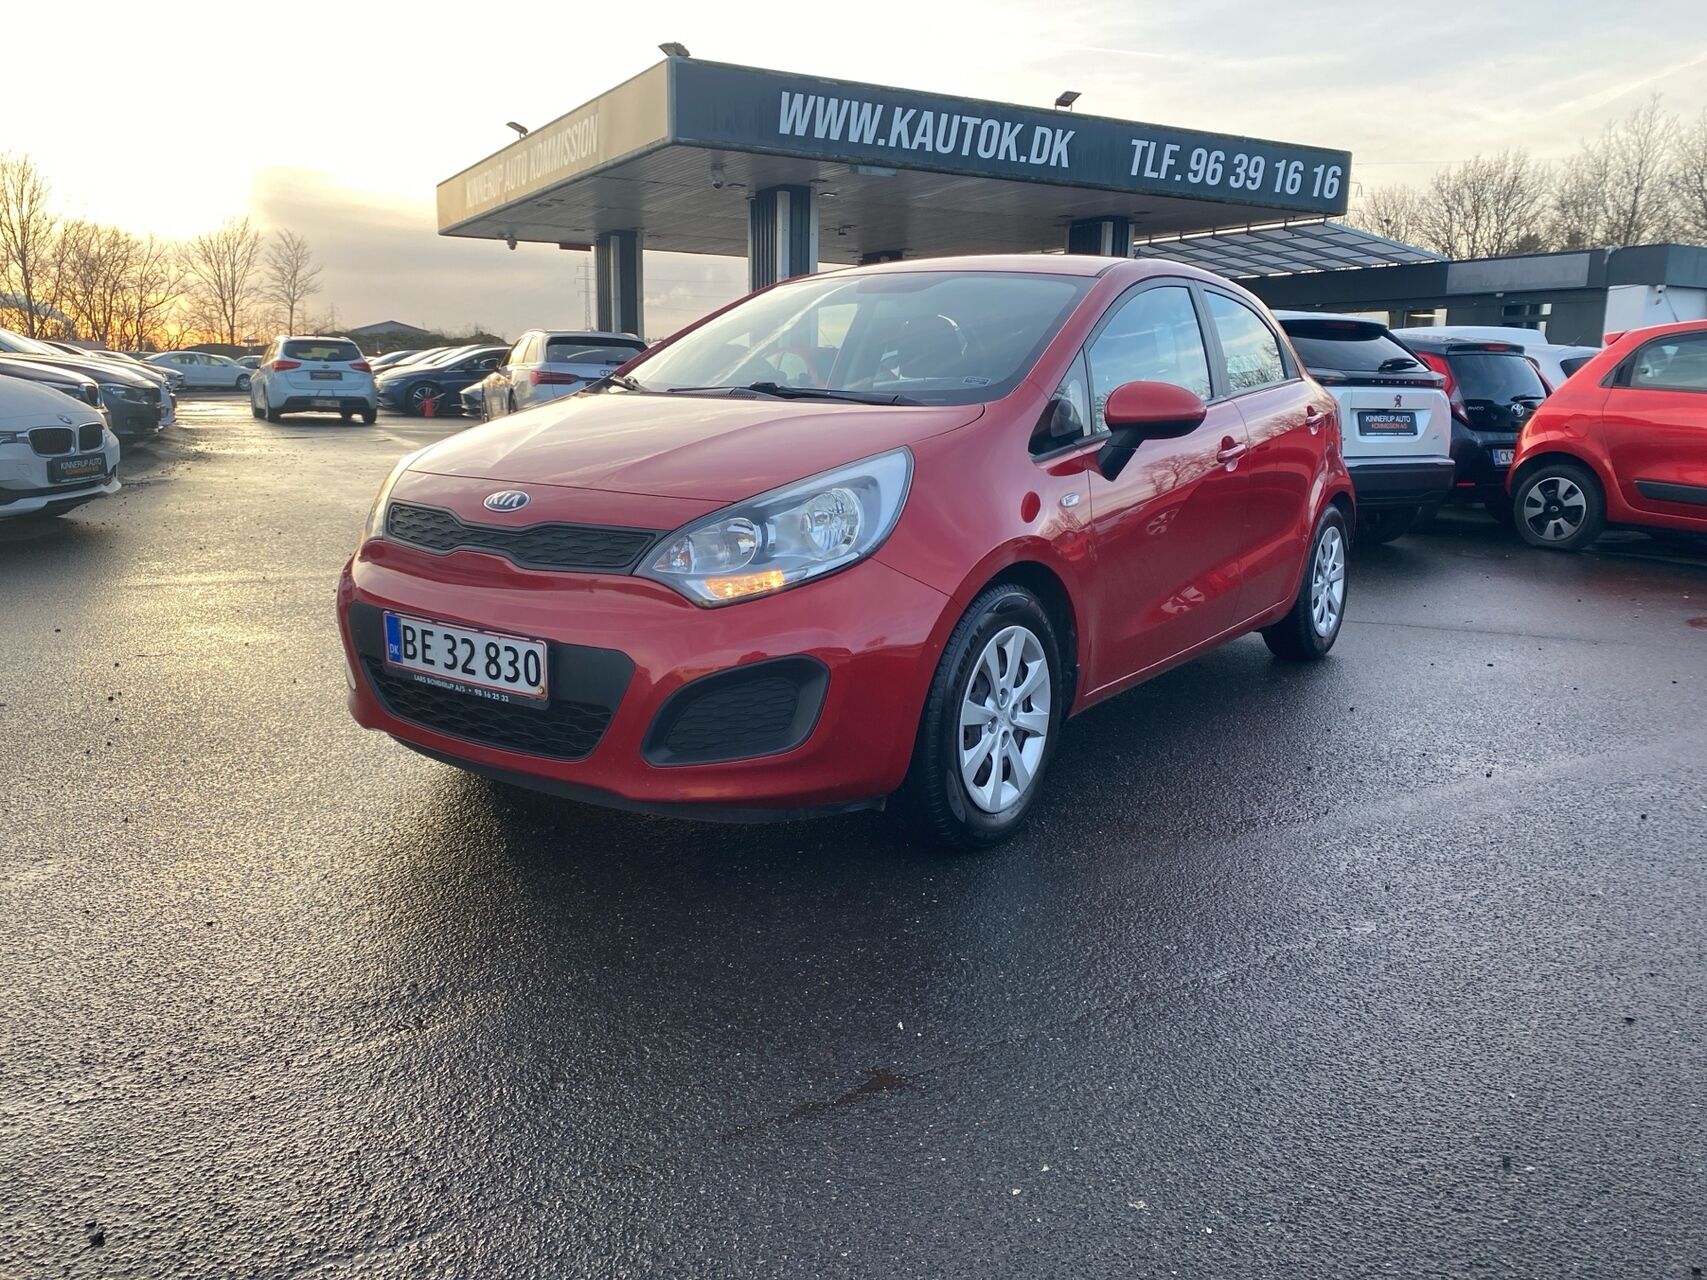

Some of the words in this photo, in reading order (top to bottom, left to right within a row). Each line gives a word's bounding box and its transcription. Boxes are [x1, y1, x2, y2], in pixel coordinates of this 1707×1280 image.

[504, 151, 528, 193] AUTO
[530, 115, 599, 182] KOMMISSION
[779, 91, 1076, 168] WWW.KAUTOK.DK
[1130, 139, 1181, 181] TLF.
[1187, 147, 1226, 186] 96
[1229, 153, 1266, 191] 39
[1274, 159, 1304, 195] 16
[1312, 164, 1342, 200] 16
[1365, 415, 1395, 423] KINNERUP
[1396, 415, 1411, 423] AUTO
[488, 491, 521, 507] KIA
[389, 644, 399, 654] DK
[402, 625, 435, 666] BE
[443, 634, 476, 675] 32
[485, 642, 541, 687] 830
